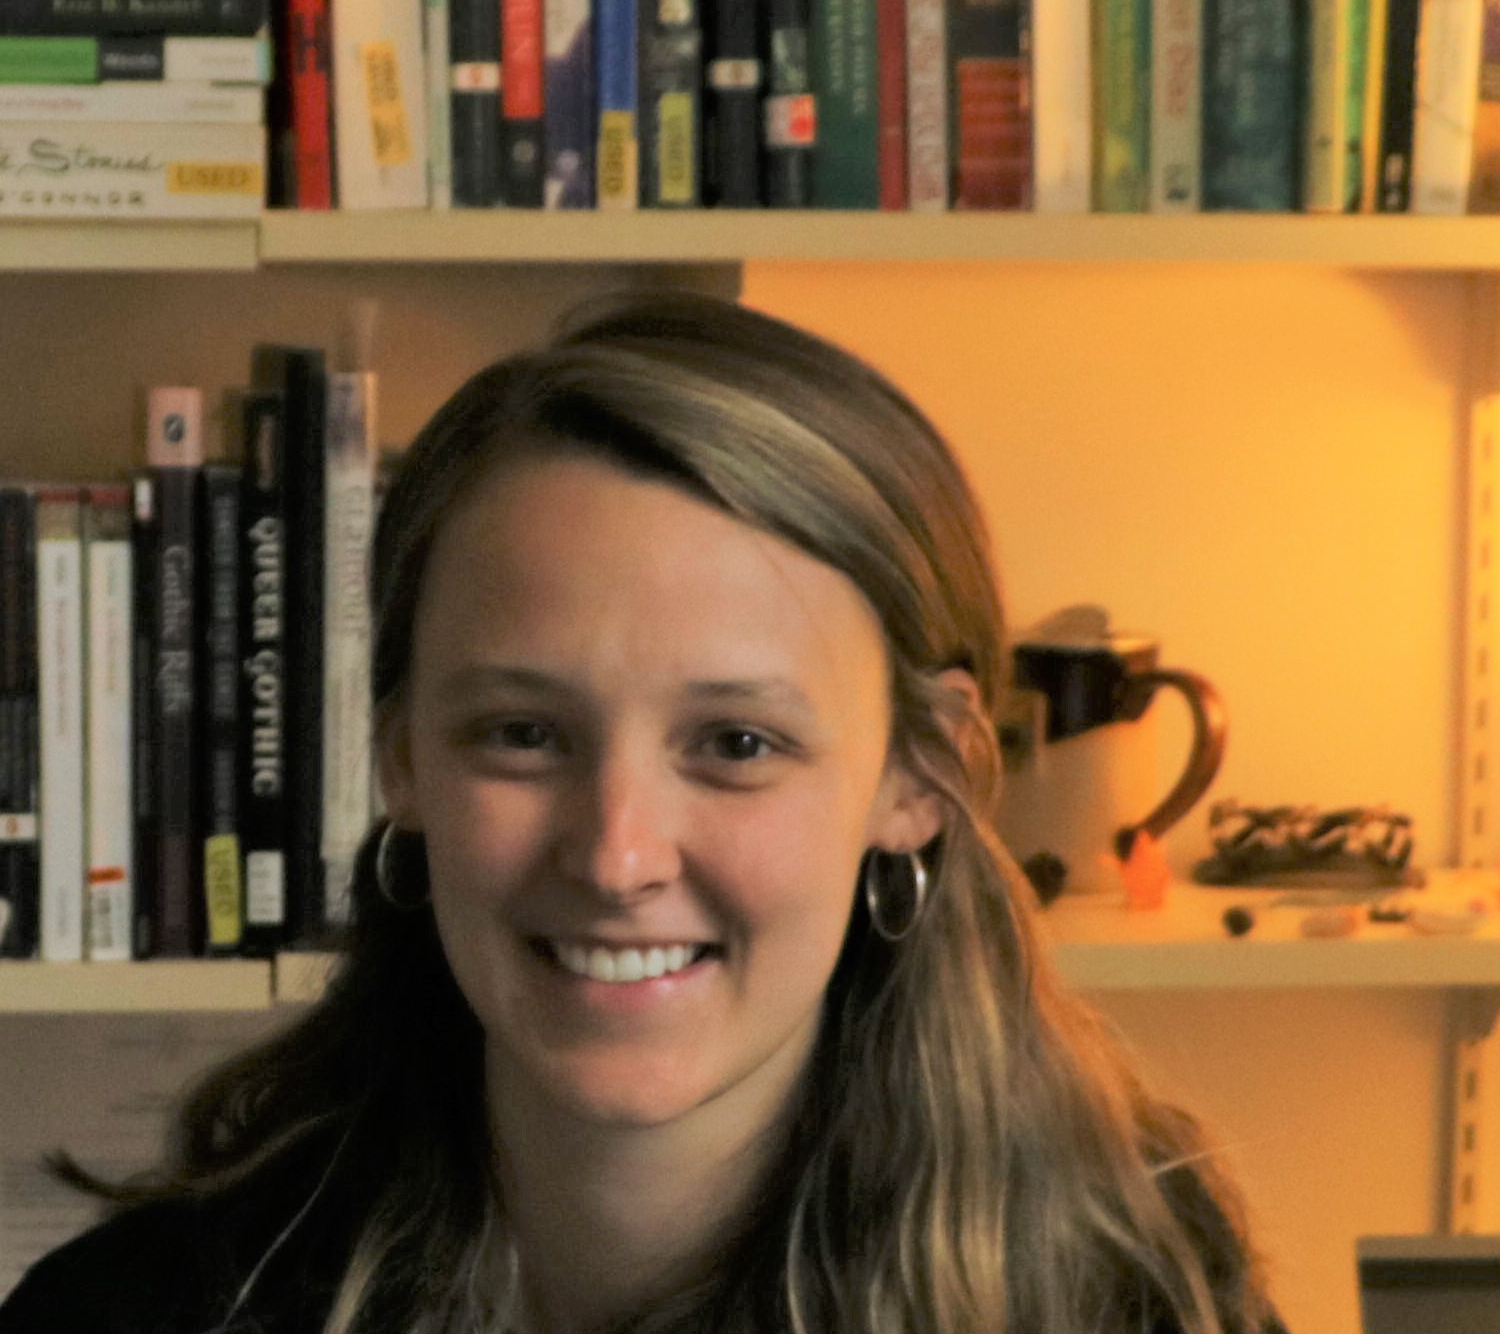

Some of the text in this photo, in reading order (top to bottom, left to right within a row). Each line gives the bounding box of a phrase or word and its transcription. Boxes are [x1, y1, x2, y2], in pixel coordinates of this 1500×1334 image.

[14, 137, 164, 177] Stories
[175, 165, 250, 186] USED
[605, 125, 629, 197] USED
[665, 114, 687, 184] USED
[157, 544, 189, 715] Gothic Riffs
[244, 516, 282, 797] QUEER GOTHIC
[211, 848, 236, 915] USED
